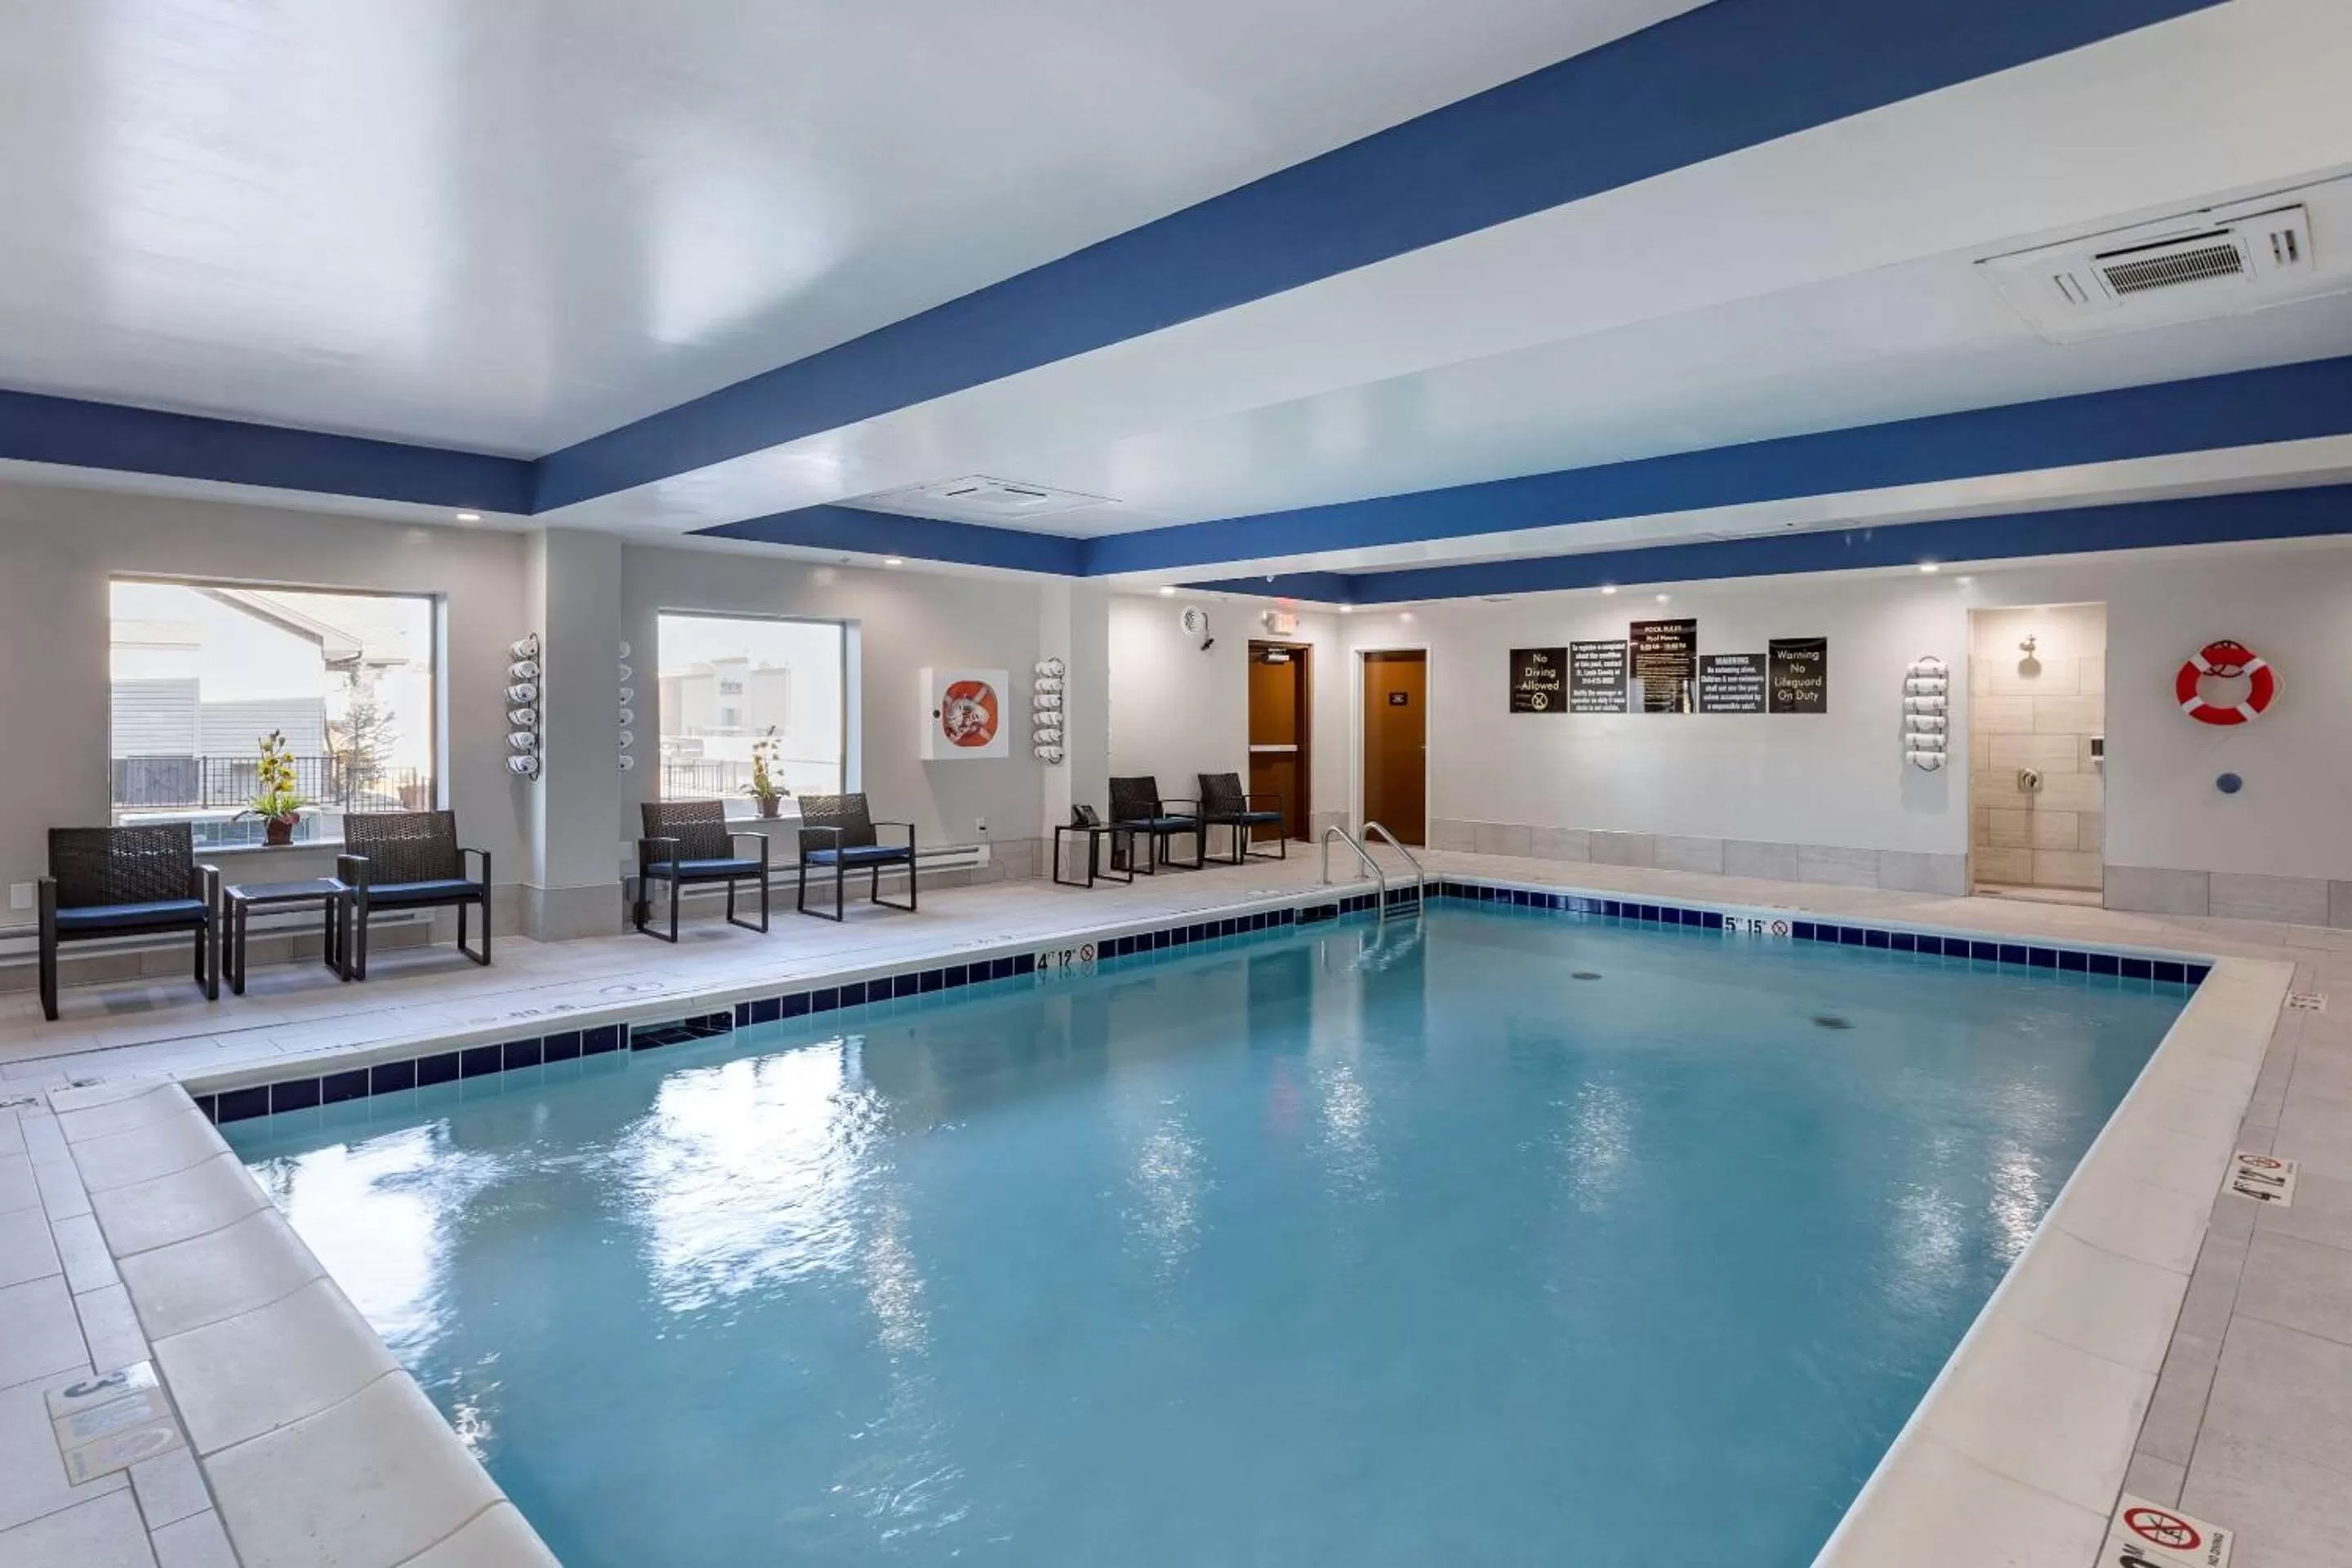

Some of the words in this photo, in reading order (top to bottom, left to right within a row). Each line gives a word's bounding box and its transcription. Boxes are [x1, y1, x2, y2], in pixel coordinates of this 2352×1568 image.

[1533, 653, 1548, 663] No
[1776, 649, 1820, 661] Warning
[1525, 666, 1557, 679] Diving
[1790, 662, 1806, 674] No
[1521, 679, 1560, 691] Allowed
[1774, 675, 1822, 688] Lifeguard
[1777, 689, 1793, 701] On
[1796, 689, 1820, 702] Duty
[1725, 916, 1735, 931] 5
[1037, 952, 1048, 969] 4
